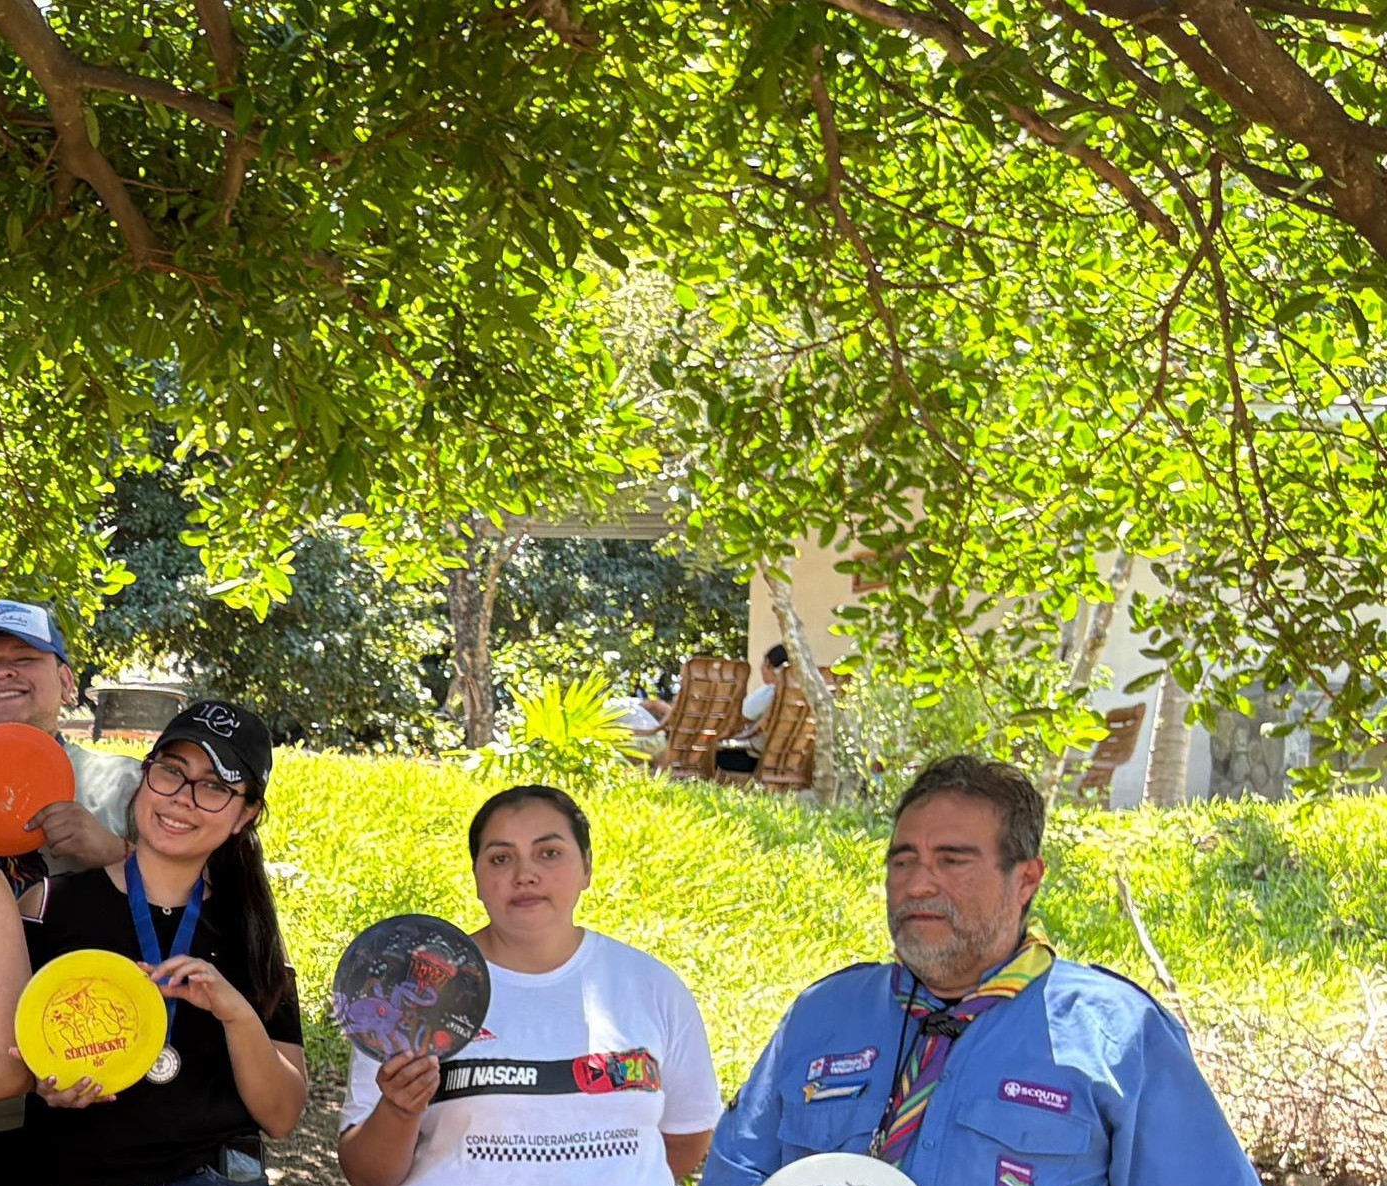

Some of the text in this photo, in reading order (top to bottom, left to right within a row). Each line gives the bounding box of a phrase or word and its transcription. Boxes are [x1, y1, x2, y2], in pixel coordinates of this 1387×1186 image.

[472, 1066, 538, 1086] NASCAR
[626, 1058, 644, 1081] 24
[466, 1135, 487, 1145] CON
[490, 1134, 526, 1145] AXALTA
[528, 1132, 587, 1146] LIDERAMOS
[589, 1131, 601, 1142] LA
